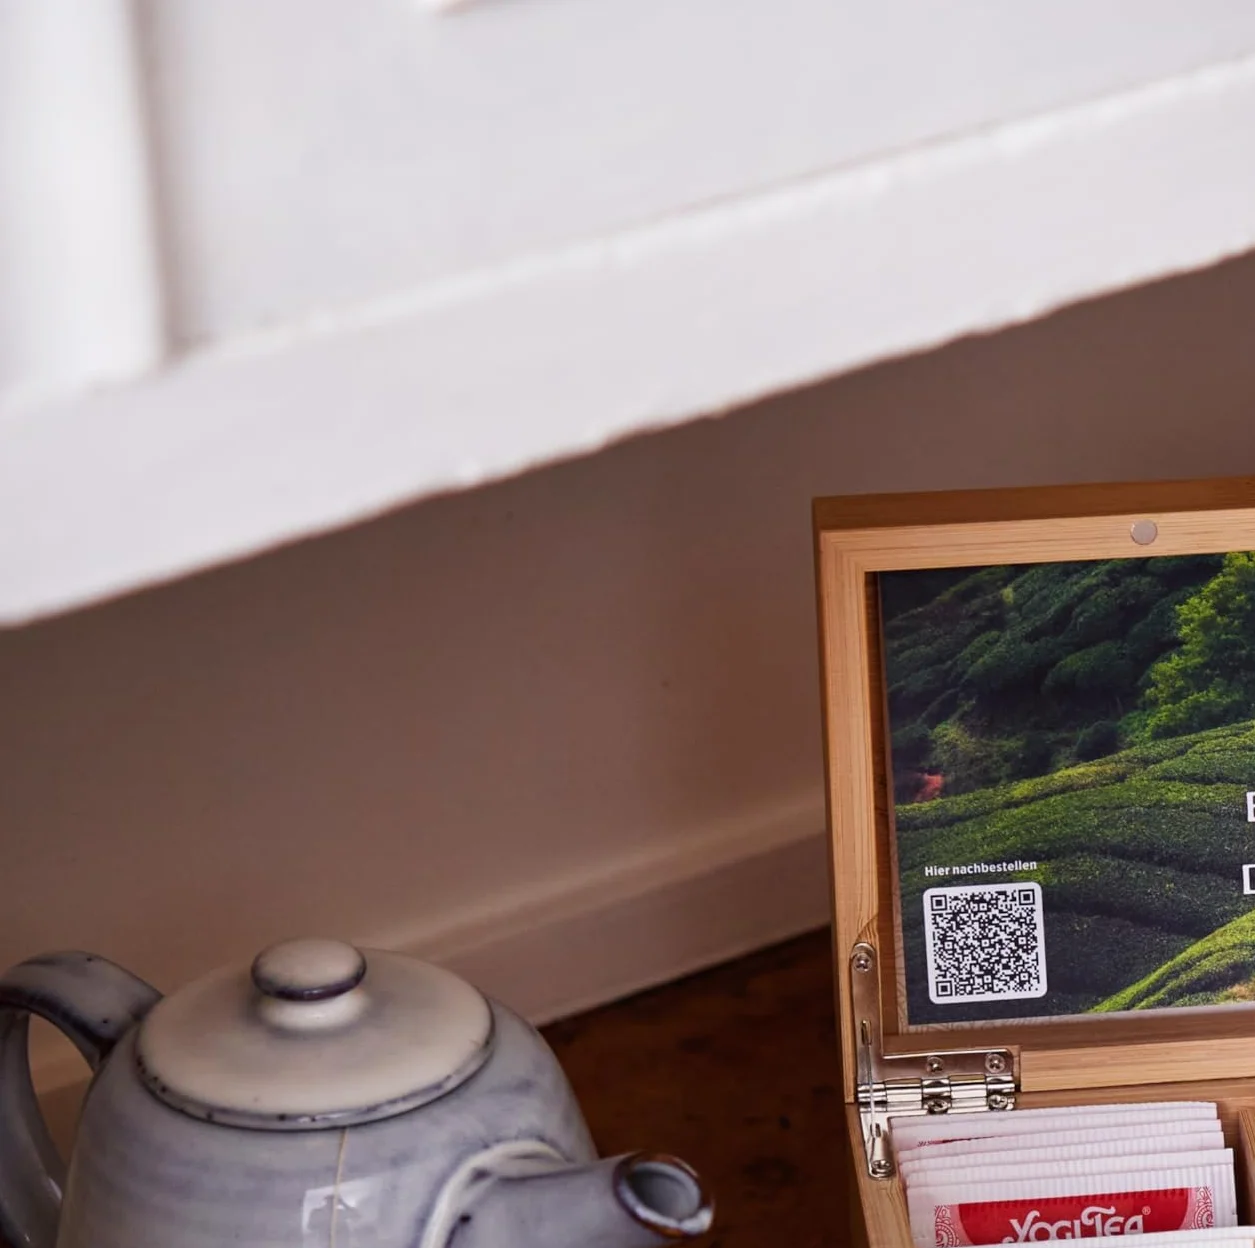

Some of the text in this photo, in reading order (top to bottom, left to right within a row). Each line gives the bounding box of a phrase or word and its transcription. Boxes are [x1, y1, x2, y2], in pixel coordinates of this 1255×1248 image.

[924, 860, 1038, 877] Hier nachbestellen
[1002, 1209, 1082, 1244] YOGI
